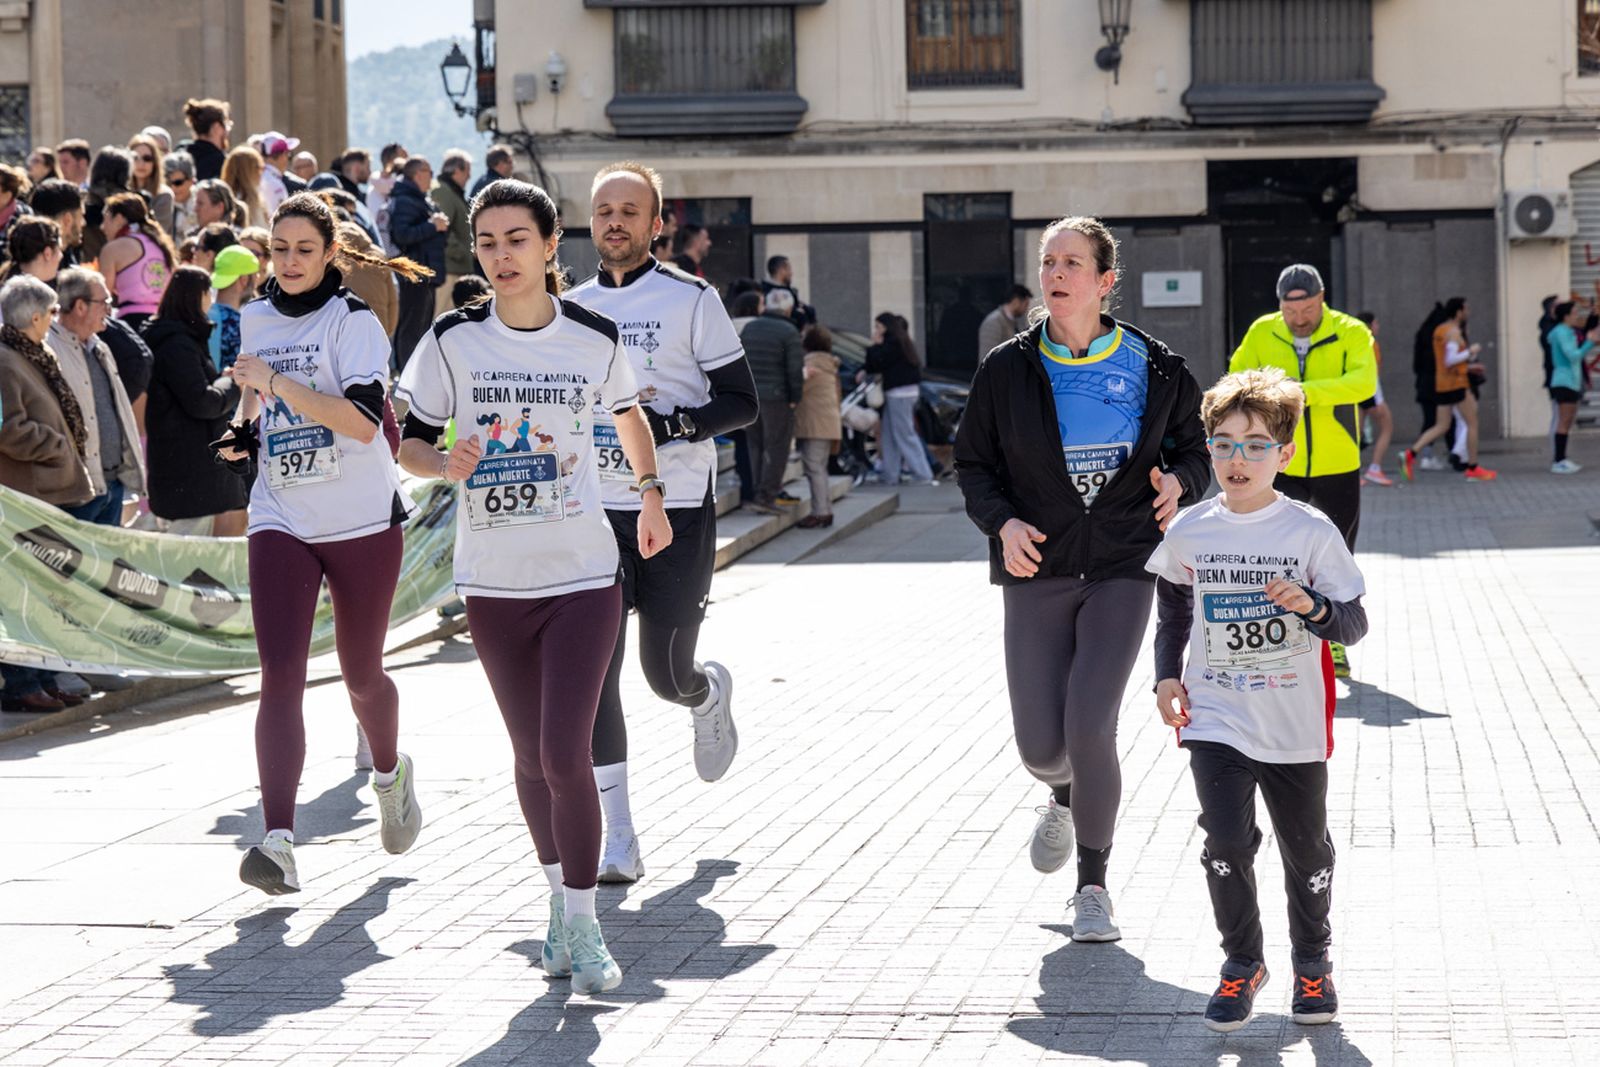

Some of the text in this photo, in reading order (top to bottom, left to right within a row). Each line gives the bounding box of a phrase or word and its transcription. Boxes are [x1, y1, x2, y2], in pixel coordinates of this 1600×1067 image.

[617, 320, 661, 330] CAMINATA
[622, 333, 639, 347] RTE
[281, 344, 319, 354] CAMINATA
[470, 371, 589, 384] VI CARRERA CAMINATA
[473, 387, 566, 405] BUENA MUERTE
[1087, 448, 1119, 458] CAMINATA
[280, 450, 317, 477] 597
[479, 461, 509, 470] CARRERA
[510, 457, 546, 467] CAMINATA
[1076, 459, 1105, 472] MUERTE
[472, 469, 531, 486] BUENA MUERTE
[1069, 472, 1107, 497] 59
[484, 483, 538, 514] 659
[1195, 554, 1299, 566] VI CARRERA CAMINATA
[1197, 569, 1226, 583] BUENA
[1220, 596, 1253, 605] CARRERA
[1213, 604, 1277, 619] BUENA MUERTE
[1226, 617, 1287, 651] 380
